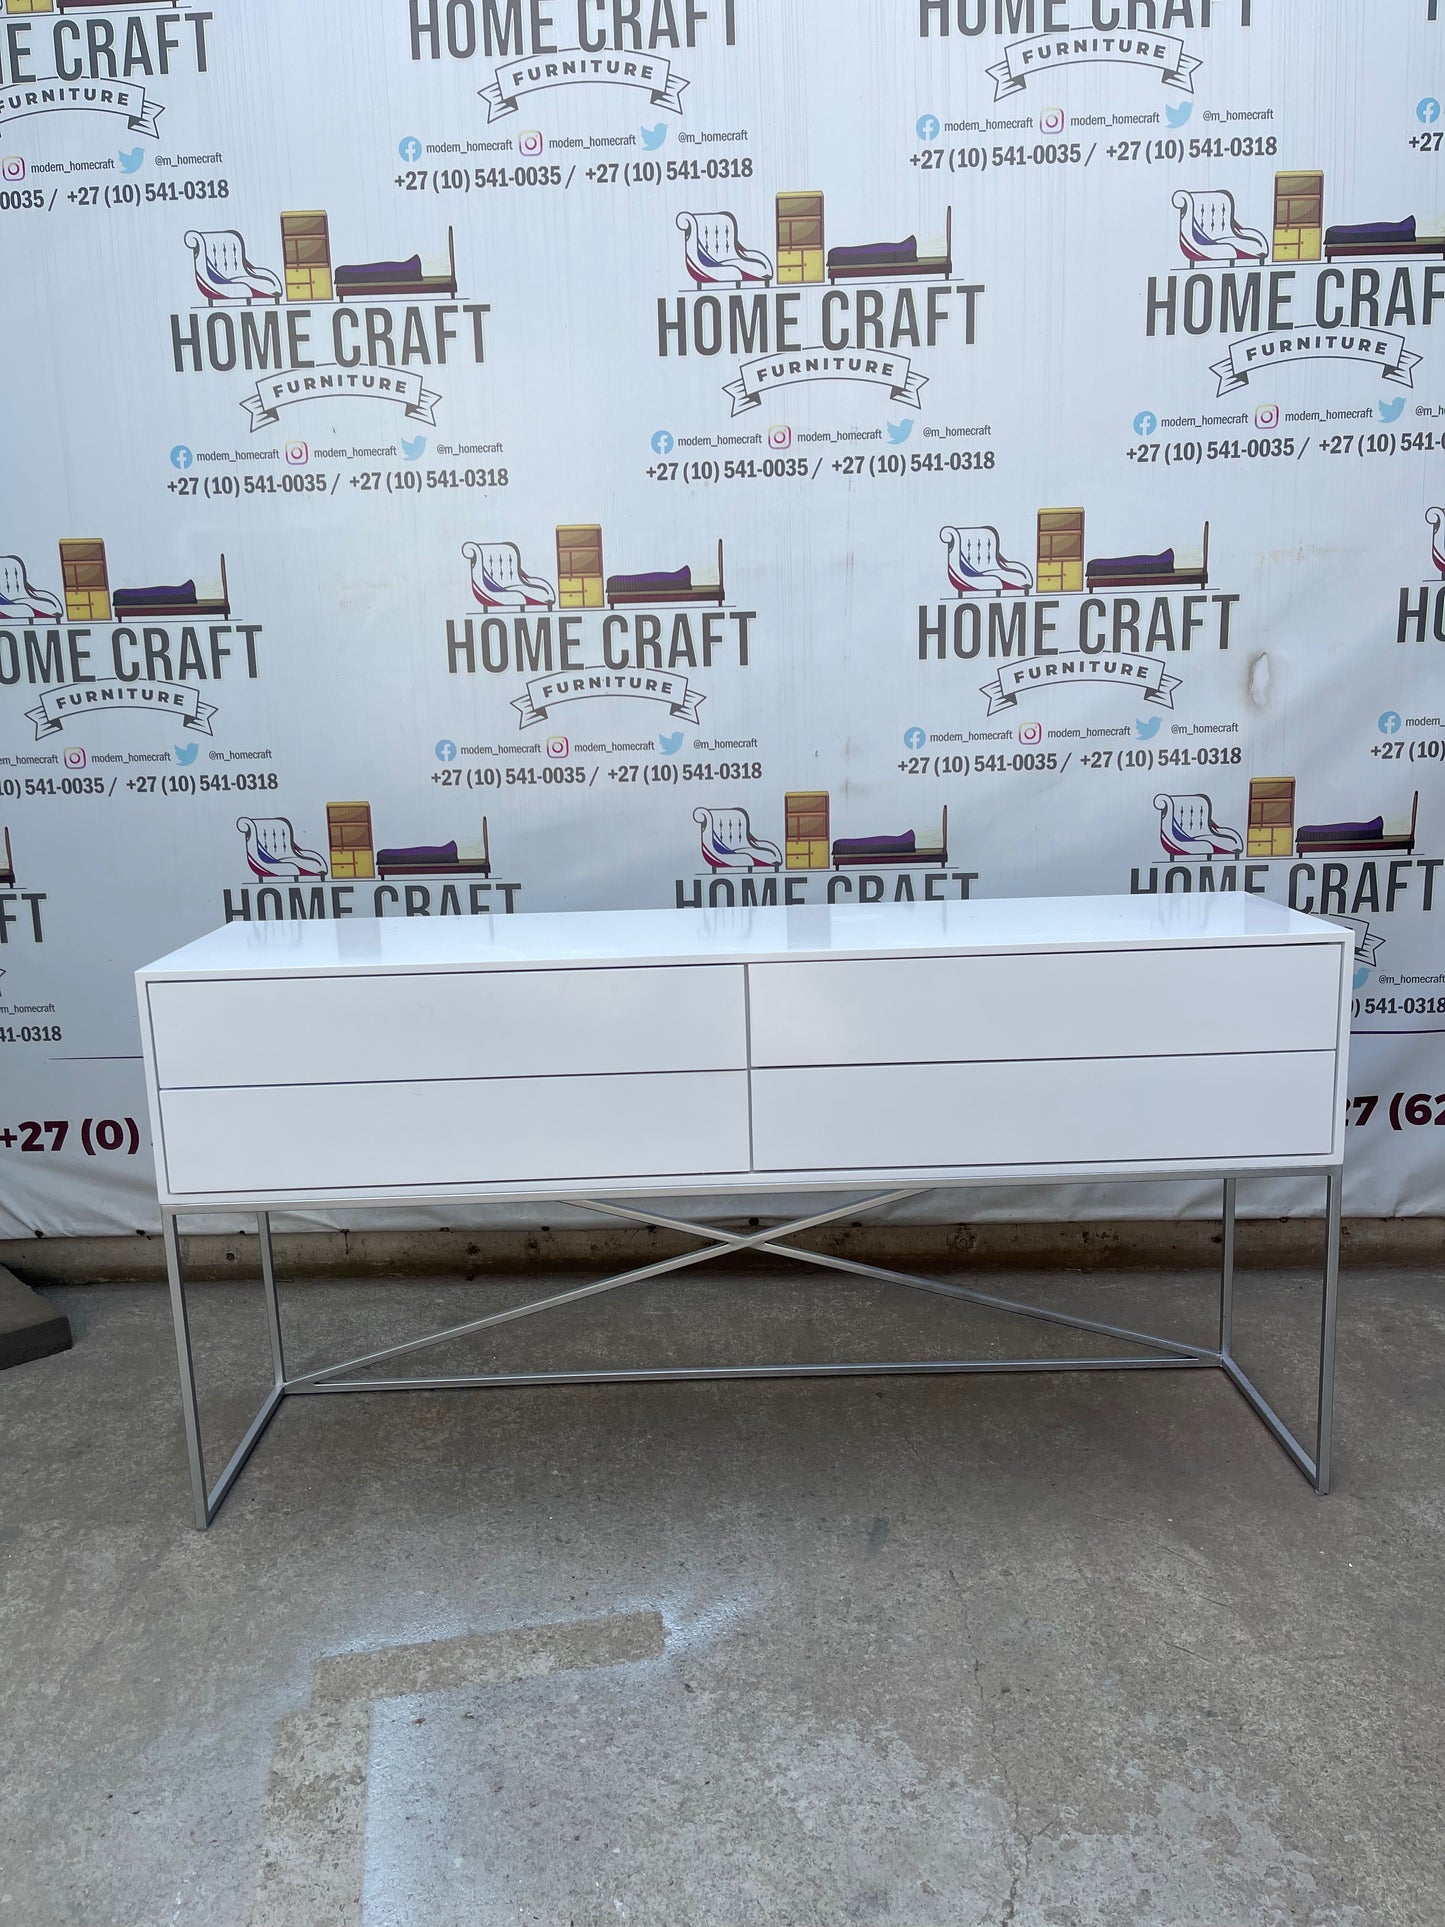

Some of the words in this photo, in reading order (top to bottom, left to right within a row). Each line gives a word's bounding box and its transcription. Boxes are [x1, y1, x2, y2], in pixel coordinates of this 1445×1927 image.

[409, 0, 557, 60] HOME
[53, 12, 213, 81] CRAFT
[1022, 39, 1166, 64] FURNITURE
[513, 60, 653, 86] FURNITURE
[1203, 109, 1273, 123] @m_homecraft
[678, 129, 748, 144] @m_homecraft
[1409, 132, 1443, 151] +27
[155, 152, 223, 167] @m_homecraft
[910, 149, 944, 169] +27
[949, 148, 987, 172] (10)
[992, 144, 1081, 166] 541-0035
[1084, 143, 1097, 167] /
[1106, 141, 1141, 160] +27
[1146, 139, 1184, 164] (10)
[1189, 136, 1277, 158] 541-0318
[395, 171, 427, 190] +27
[433, 169, 470, 194] (10)
[475, 166, 561, 188] 541-0035
[565, 165, 576, 189] /
[585, 163, 619, 183] +27
[624, 162, 661, 186] (10)
[666, 158, 753, 180] 541-0318
[48, 189, 58, 211] /
[67, 186, 99, 205] +27
[105, 184, 140, 208] (10)
[145, 179, 229, 202] 541-0318
[1146, 271, 1295, 336] HOME
[657, 293, 801, 357] HOME
[822, 284, 985, 351] CRAFT
[170, 310, 315, 372] HOME
[332, 303, 491, 367] CRAFT
[1246, 336, 1387, 361] FURNITURE
[757, 358, 893, 382] FURNITURE
[273, 375, 406, 398] FURNITURE
[923, 425, 991, 439] @m_homecraft
[437, 442, 503, 456] @m_homecraft
[1126, 444, 1160, 462] +27
[1165, 442, 1202, 465] (10)
[1207, 438, 1294, 459] 541-0035
[1297, 437, 1310, 460] /
[1319, 435, 1353, 454] +27
[1358, 434, 1396, 457] (10)
[646, 463, 678, 481] +27
[684, 461, 719, 484] (10)
[724, 458, 808, 478] 541-0035
[811, 457, 823, 479] /
[832, 456, 865, 474] +27
[870, 455, 906, 477] (10)
[911, 451, 995, 472] 541-0318
[167, 477, 199, 495] +27
[204, 476, 240, 498] (10)
[244, 474, 326, 493] 541-0035
[331, 473, 340, 495] /
[350, 472, 381, 490] +27
[387, 471, 422, 493] (10)
[427, 468, 508, 488] 541-0318
[919, 601, 1059, 660] HOME
[1079, 594, 1240, 654] CRAFT
[112, 625, 262, 682] CRAFT
[446, 617, 584, 673] HOME
[603, 611, 756, 670] CRAFT
[1014, 661, 1148, 683] FURNITURE
[56, 688, 184, 709] FURNITURE
[543, 676, 672, 698] FURNITURE
[1171, 723, 1238, 735] @m_homecraft
[209, 749, 272, 761] @m_homecraft
[694, 738, 757, 750] @m_homecraft
[1371, 742, 1404, 759] +27
[1409, 741, 1445, 762] (10)
[898, 757, 930, 774] +27
[934, 756, 969, 777] (10)
[974, 753, 1057, 772] 541-0035
[1060, 752, 1072, 773] /
[1081, 751, 1113, 768] +27
[1117, 750, 1153, 771] (10)
[1158, 747, 1241, 766] 541-0318
[25, 777, 104, 795] 541-0035
[108, 777, 117, 797] /
[126, 776, 156, 792] +27
[162, 775, 195, 796] (10)
[200, 773, 278, 791] 541-0318
[431, 769, 462, 786] +27
[467, 769, 501, 789] (10)
[506, 767, 585, 784] 541-0035
[589, 767, 599, 786] /
[608, 766, 639, 782] +27
[644, 765, 678, 785] (10)
[683, 762, 762, 780] 541-0318
[1288, 859, 1444, 914] CRAFT
[1365, 997, 1445, 1014] 541-0318
[0, 1121, 68, 1151] +27
[81, 1118, 139, 1155] (0)
